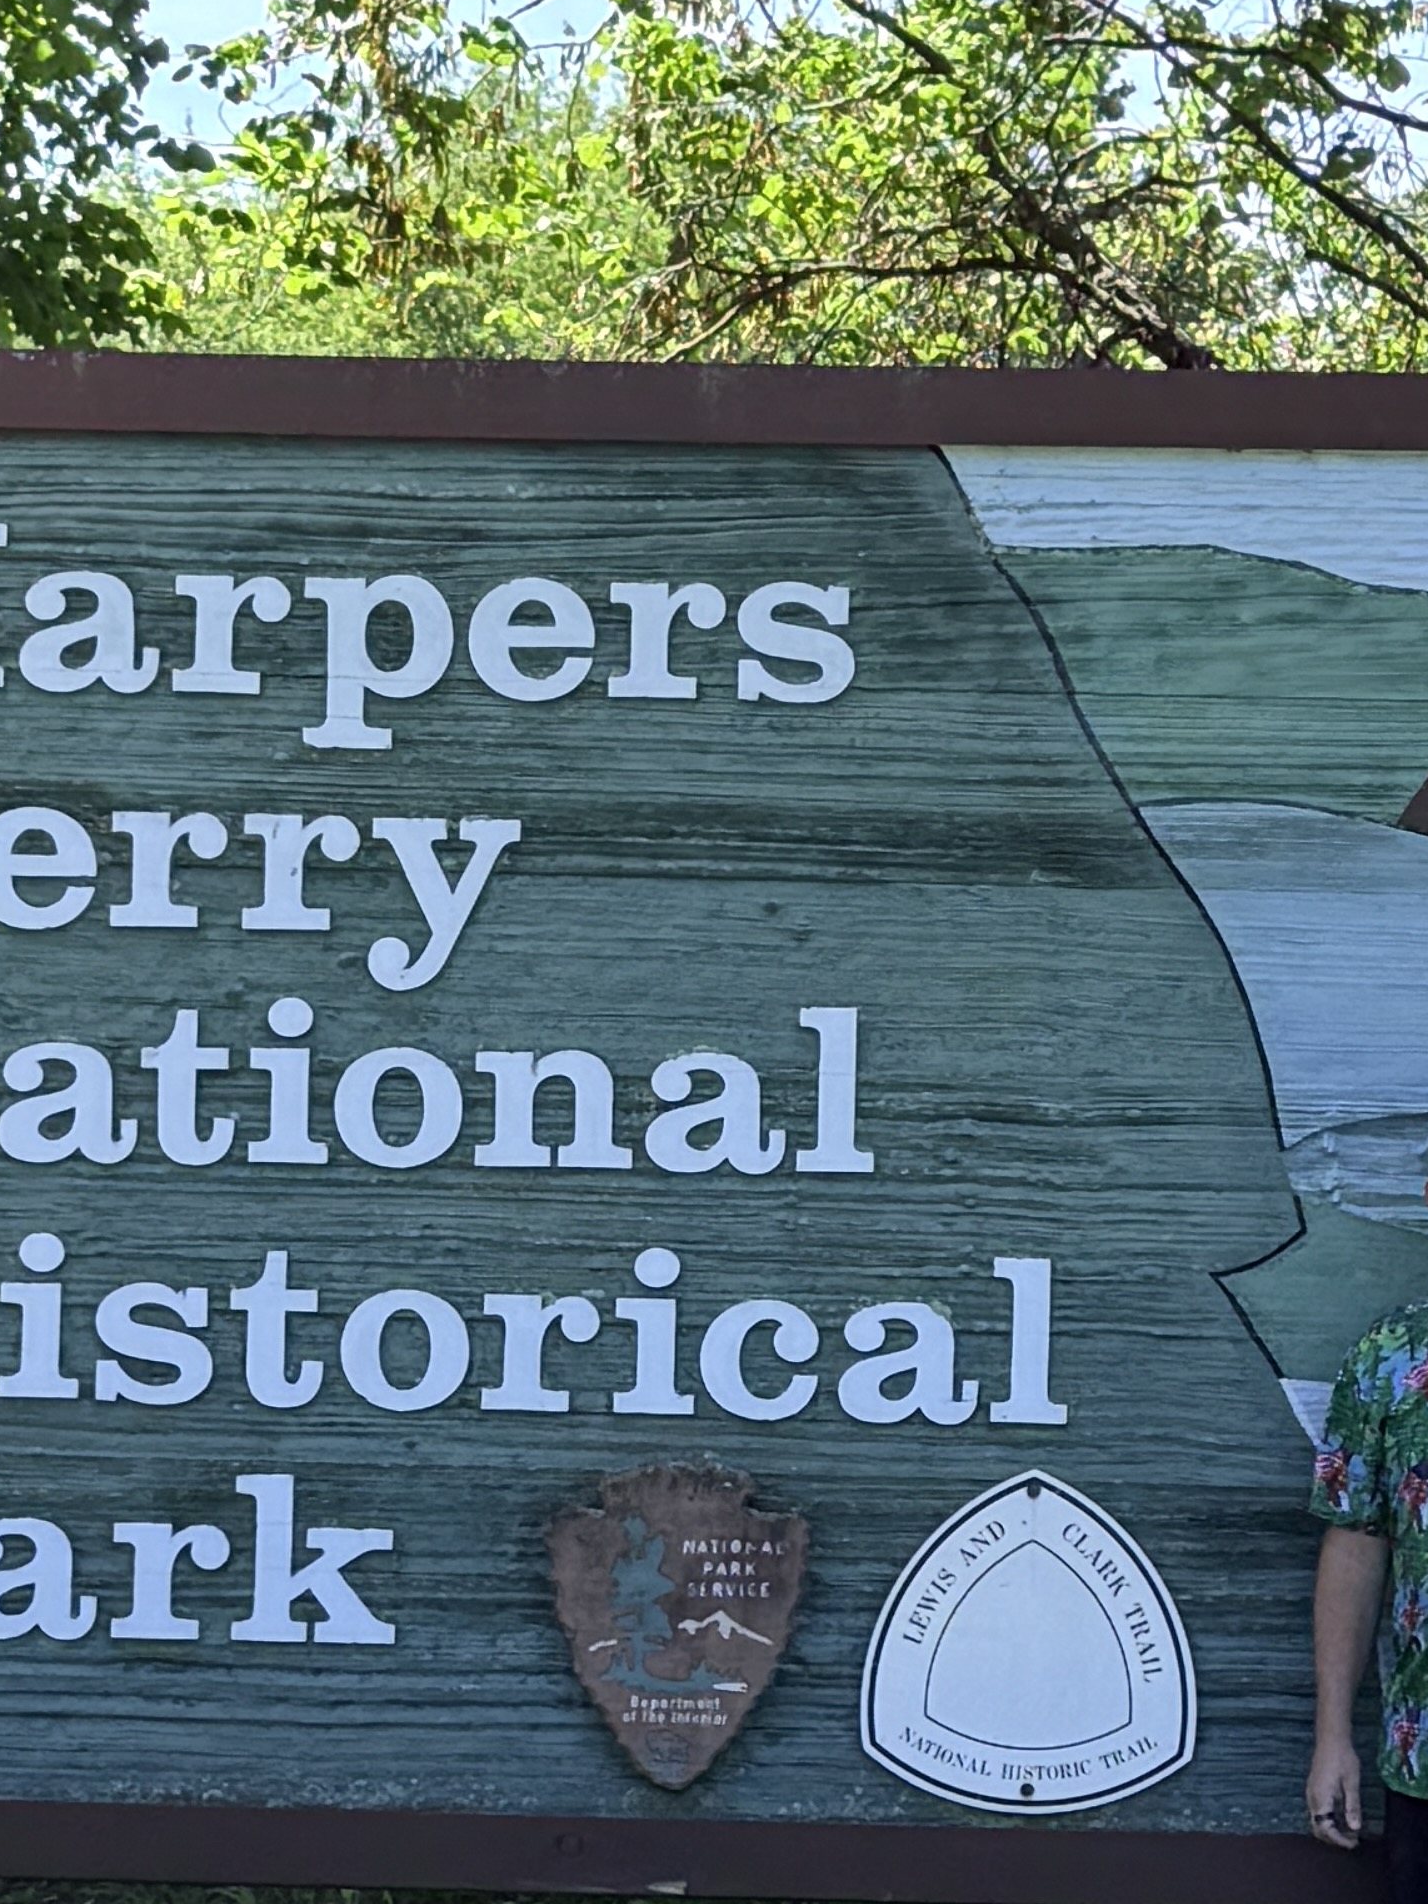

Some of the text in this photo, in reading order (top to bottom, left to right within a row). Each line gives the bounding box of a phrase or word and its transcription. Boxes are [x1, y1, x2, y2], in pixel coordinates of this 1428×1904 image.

[703, 1561, 756, 1576] PARK
[687, 1582, 771, 1598] SERVICE
[902, 1519, 1163, 1683] LEWIS AND CLARK TRAIL
[898, 1726, 1159, 1781] NATIONAL HISTORIC TRAIL
